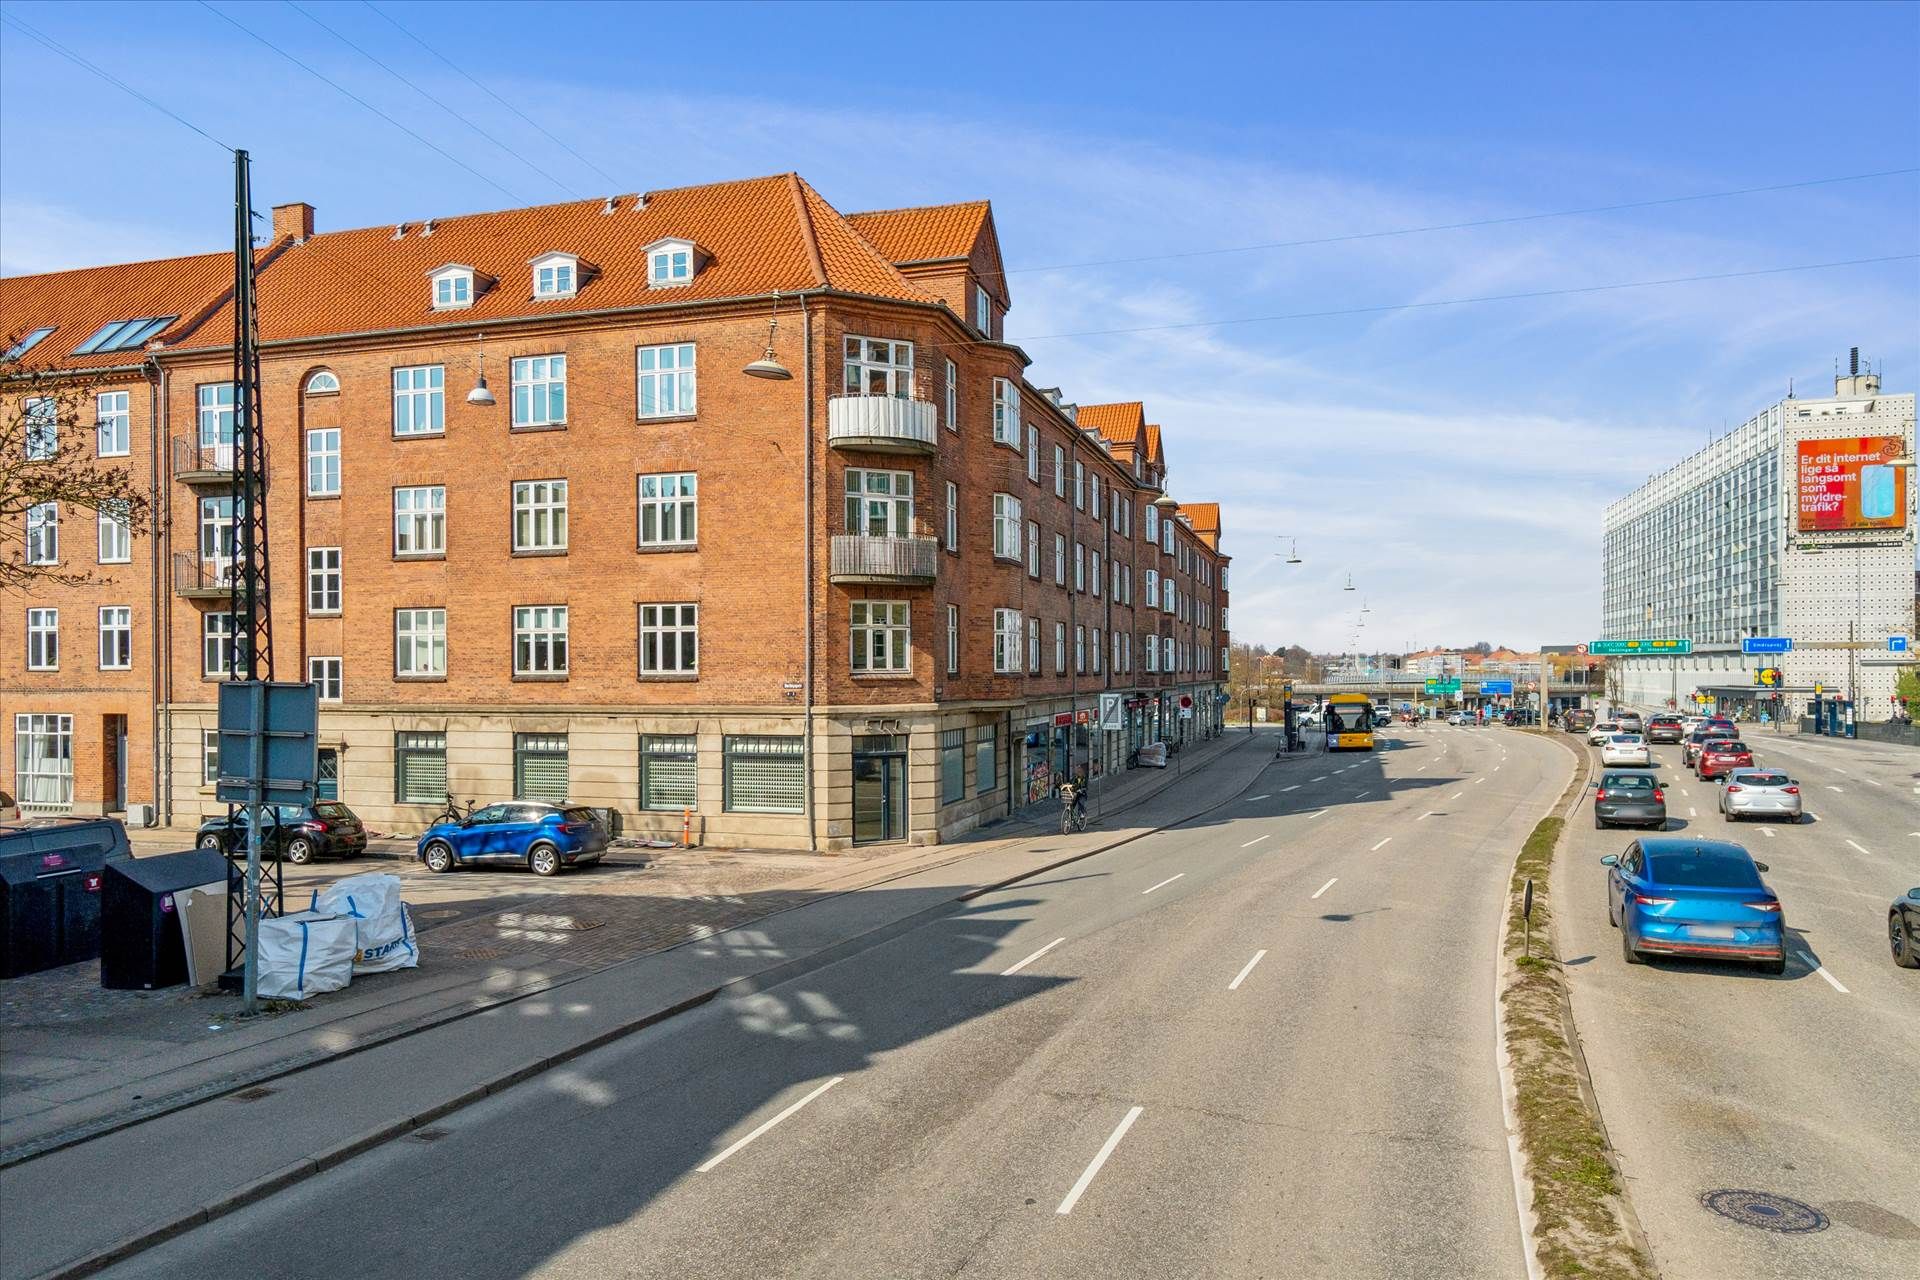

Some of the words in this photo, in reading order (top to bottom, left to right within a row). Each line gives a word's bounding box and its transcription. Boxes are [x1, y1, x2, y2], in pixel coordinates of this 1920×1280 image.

[1801, 455, 1814, 465] Er
[1816, 453, 1831, 463] dit
[1833, 452, 1880, 463] internet
[1801, 465, 1822, 475] lige
[1825, 462, 1839, 473] så
[1801, 473, 1857, 485] langsomt
[1801, 484, 1827, 492] som
[1801, 492, 1847, 504] myldre-
[1801, 502, 1839, 512] trafik?
[1106, 699, 1115, 712] P
